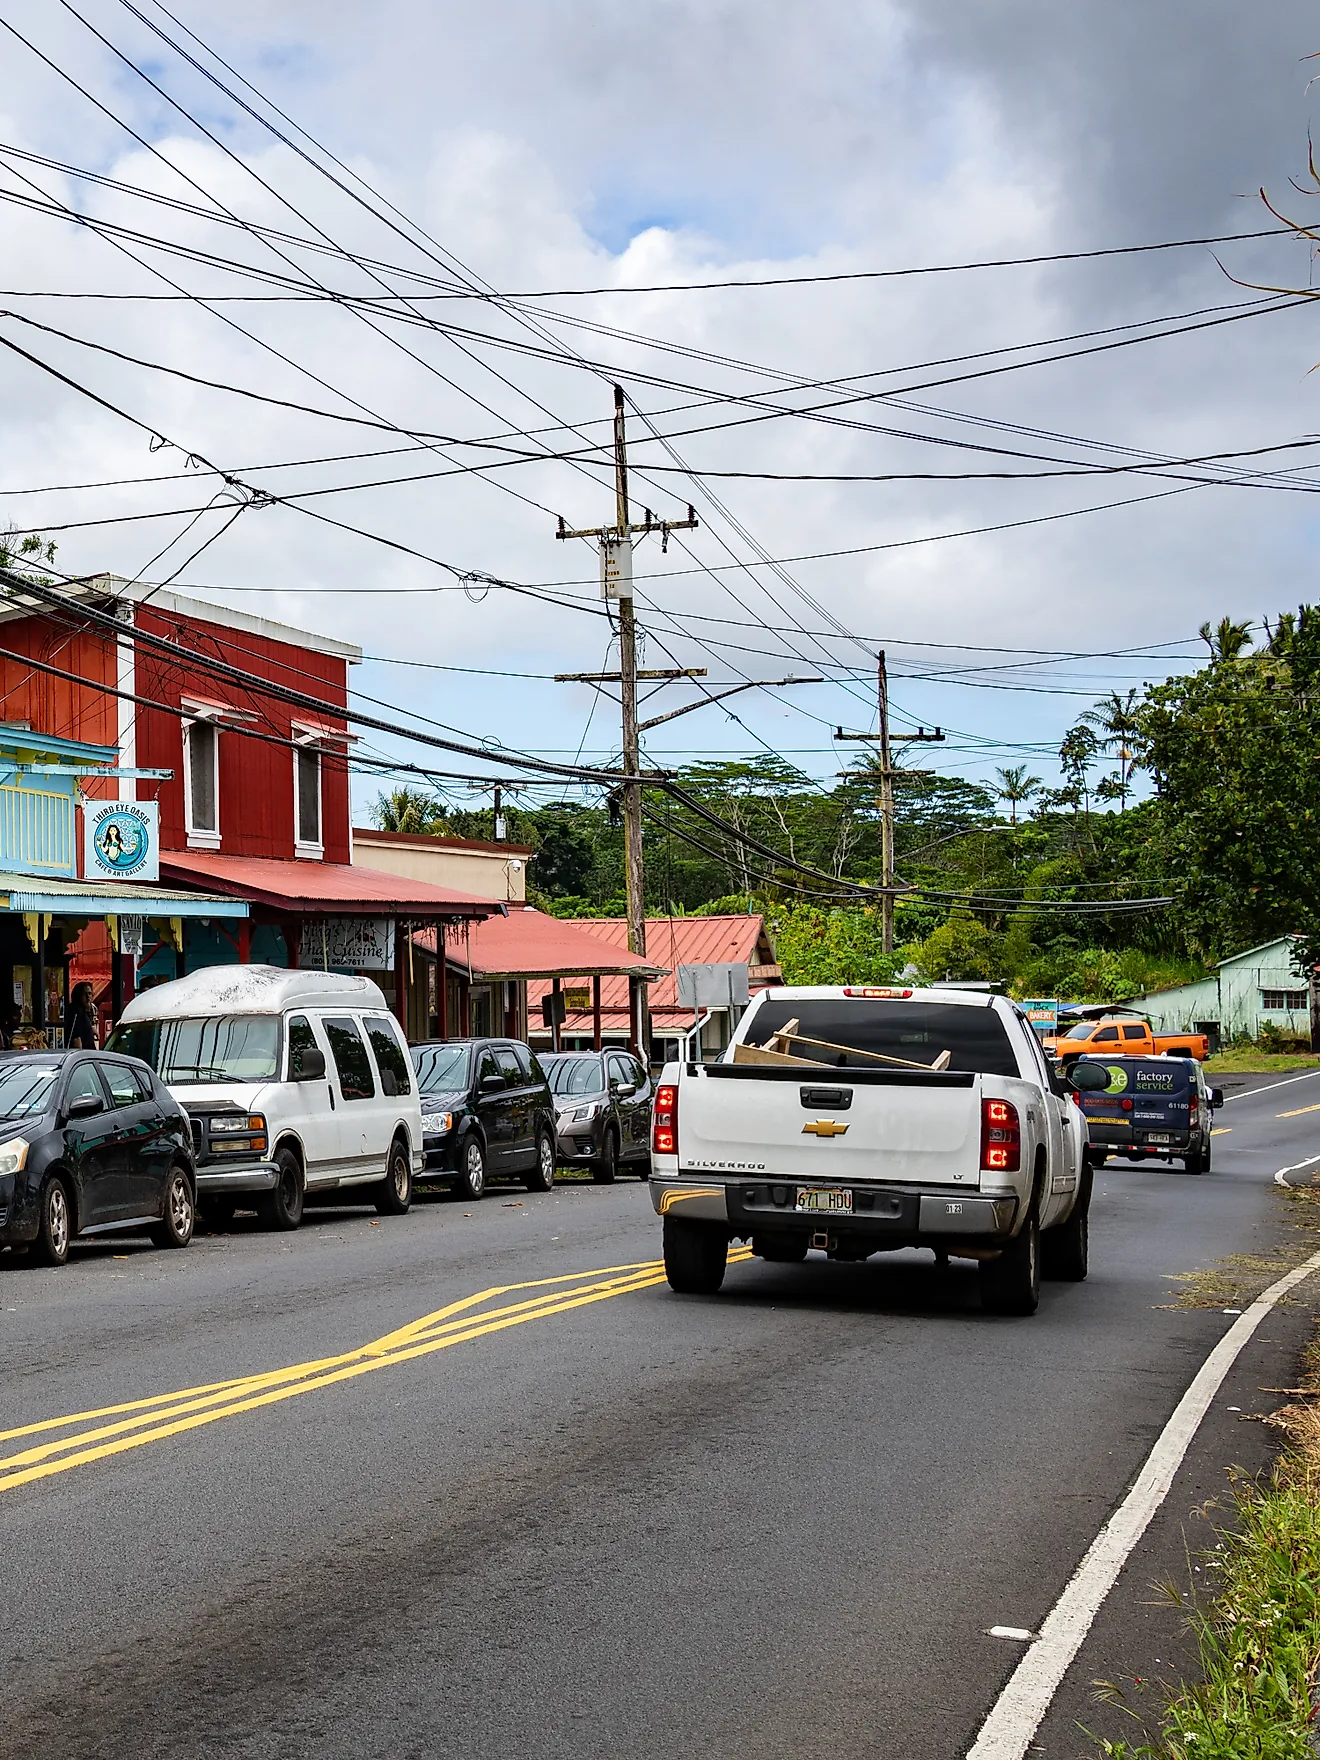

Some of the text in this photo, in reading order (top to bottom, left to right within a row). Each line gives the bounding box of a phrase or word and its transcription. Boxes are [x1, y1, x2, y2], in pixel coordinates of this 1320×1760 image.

[92, 804, 151, 825] THIRD EYE OASIS
[94, 859, 107, 872] CAFE
[125, 859, 148, 876] GALLERY
[1030, 1012, 1053, 1020] BAKERY
[1136, 1070, 1173, 1084] factory
[1136, 1081, 1174, 1090] service
[1168, 1102, 1189, 1110] 61180
[687, 1160, 766, 1170] SILVERADO
[798, 1192, 852, 1208] 671 HDU
